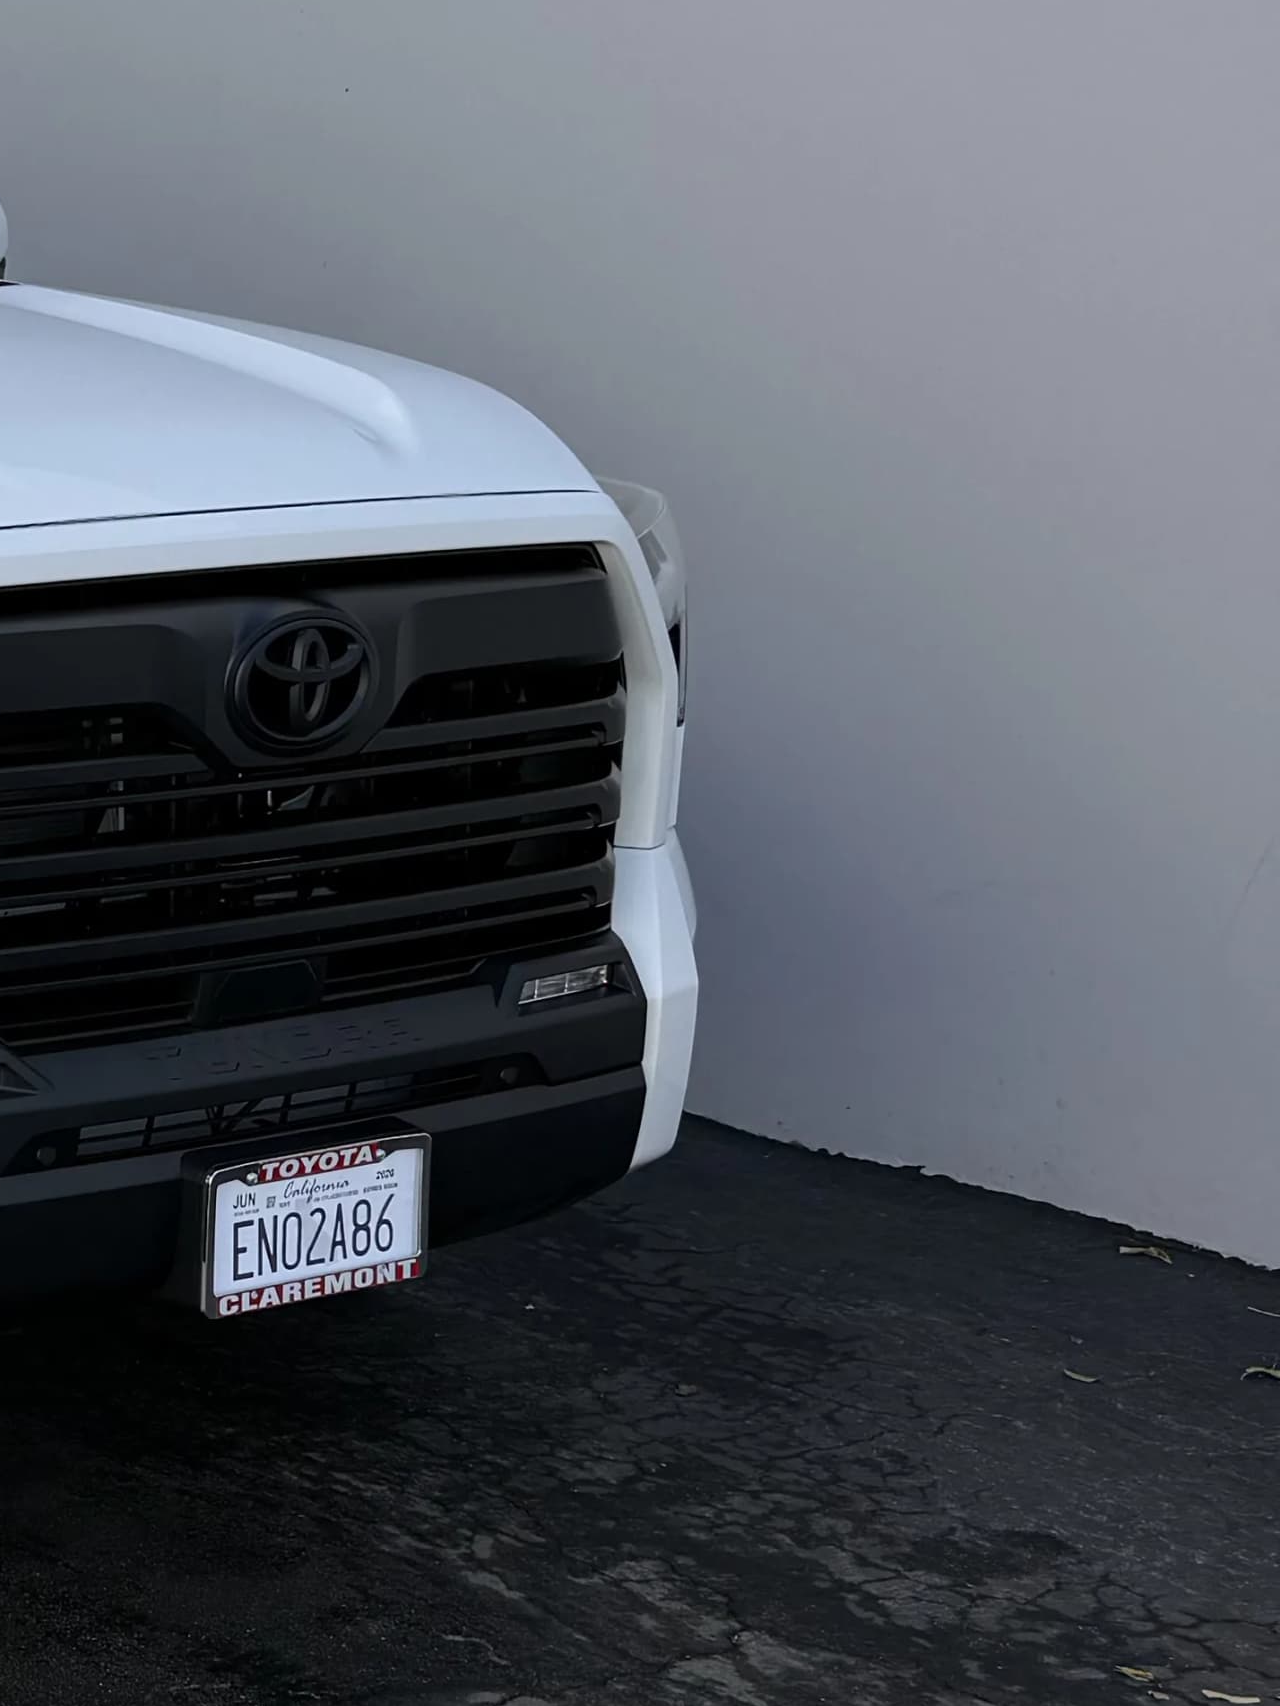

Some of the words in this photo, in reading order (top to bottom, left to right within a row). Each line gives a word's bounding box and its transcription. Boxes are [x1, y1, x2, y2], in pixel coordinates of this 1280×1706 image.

[260, 1143, 376, 1183] TOYOTA
[232, 1192, 257, 1210] JUN
[283, 1177, 351, 1203] California
[231, 1192, 395, 1282] EN02A86
[217, 1257, 418, 1317] CLAREMONT
